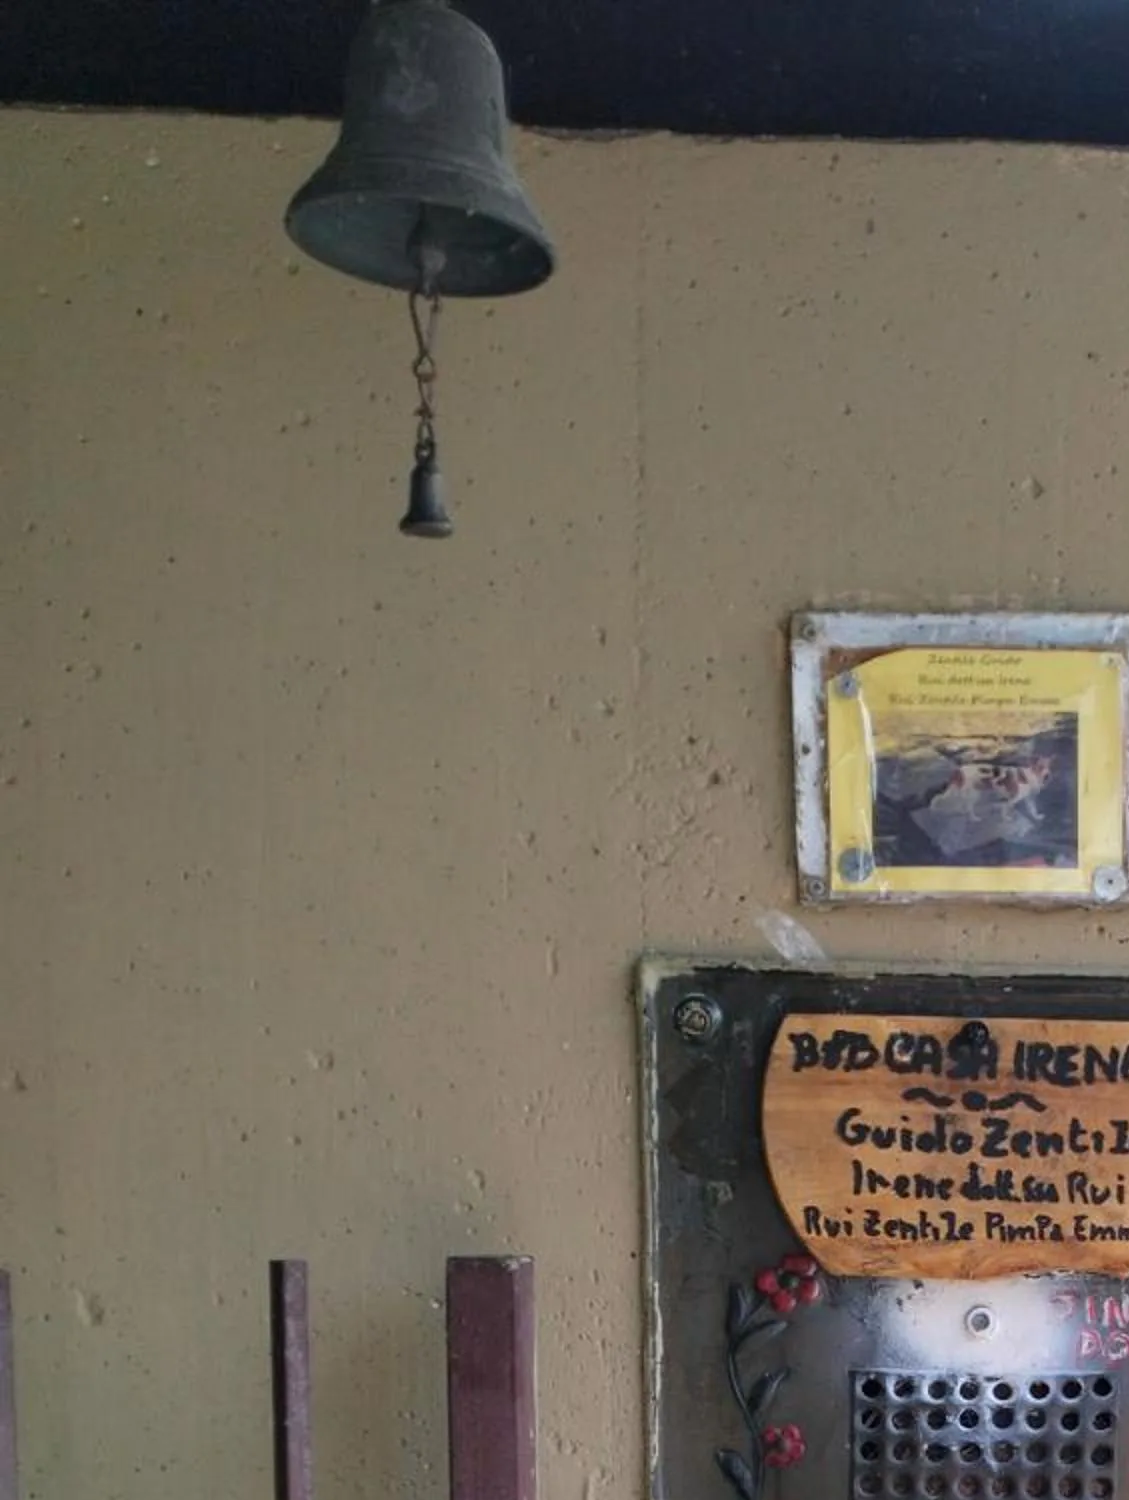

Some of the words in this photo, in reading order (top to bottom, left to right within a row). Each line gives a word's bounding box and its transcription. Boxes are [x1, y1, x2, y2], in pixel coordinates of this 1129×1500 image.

[836, 1107, 974, 1154] Guido
[851, 1159, 954, 1200] Irene
[1067, 1170, 1126, 1205] Rui
[803, 1205, 853, 1238] Rui
